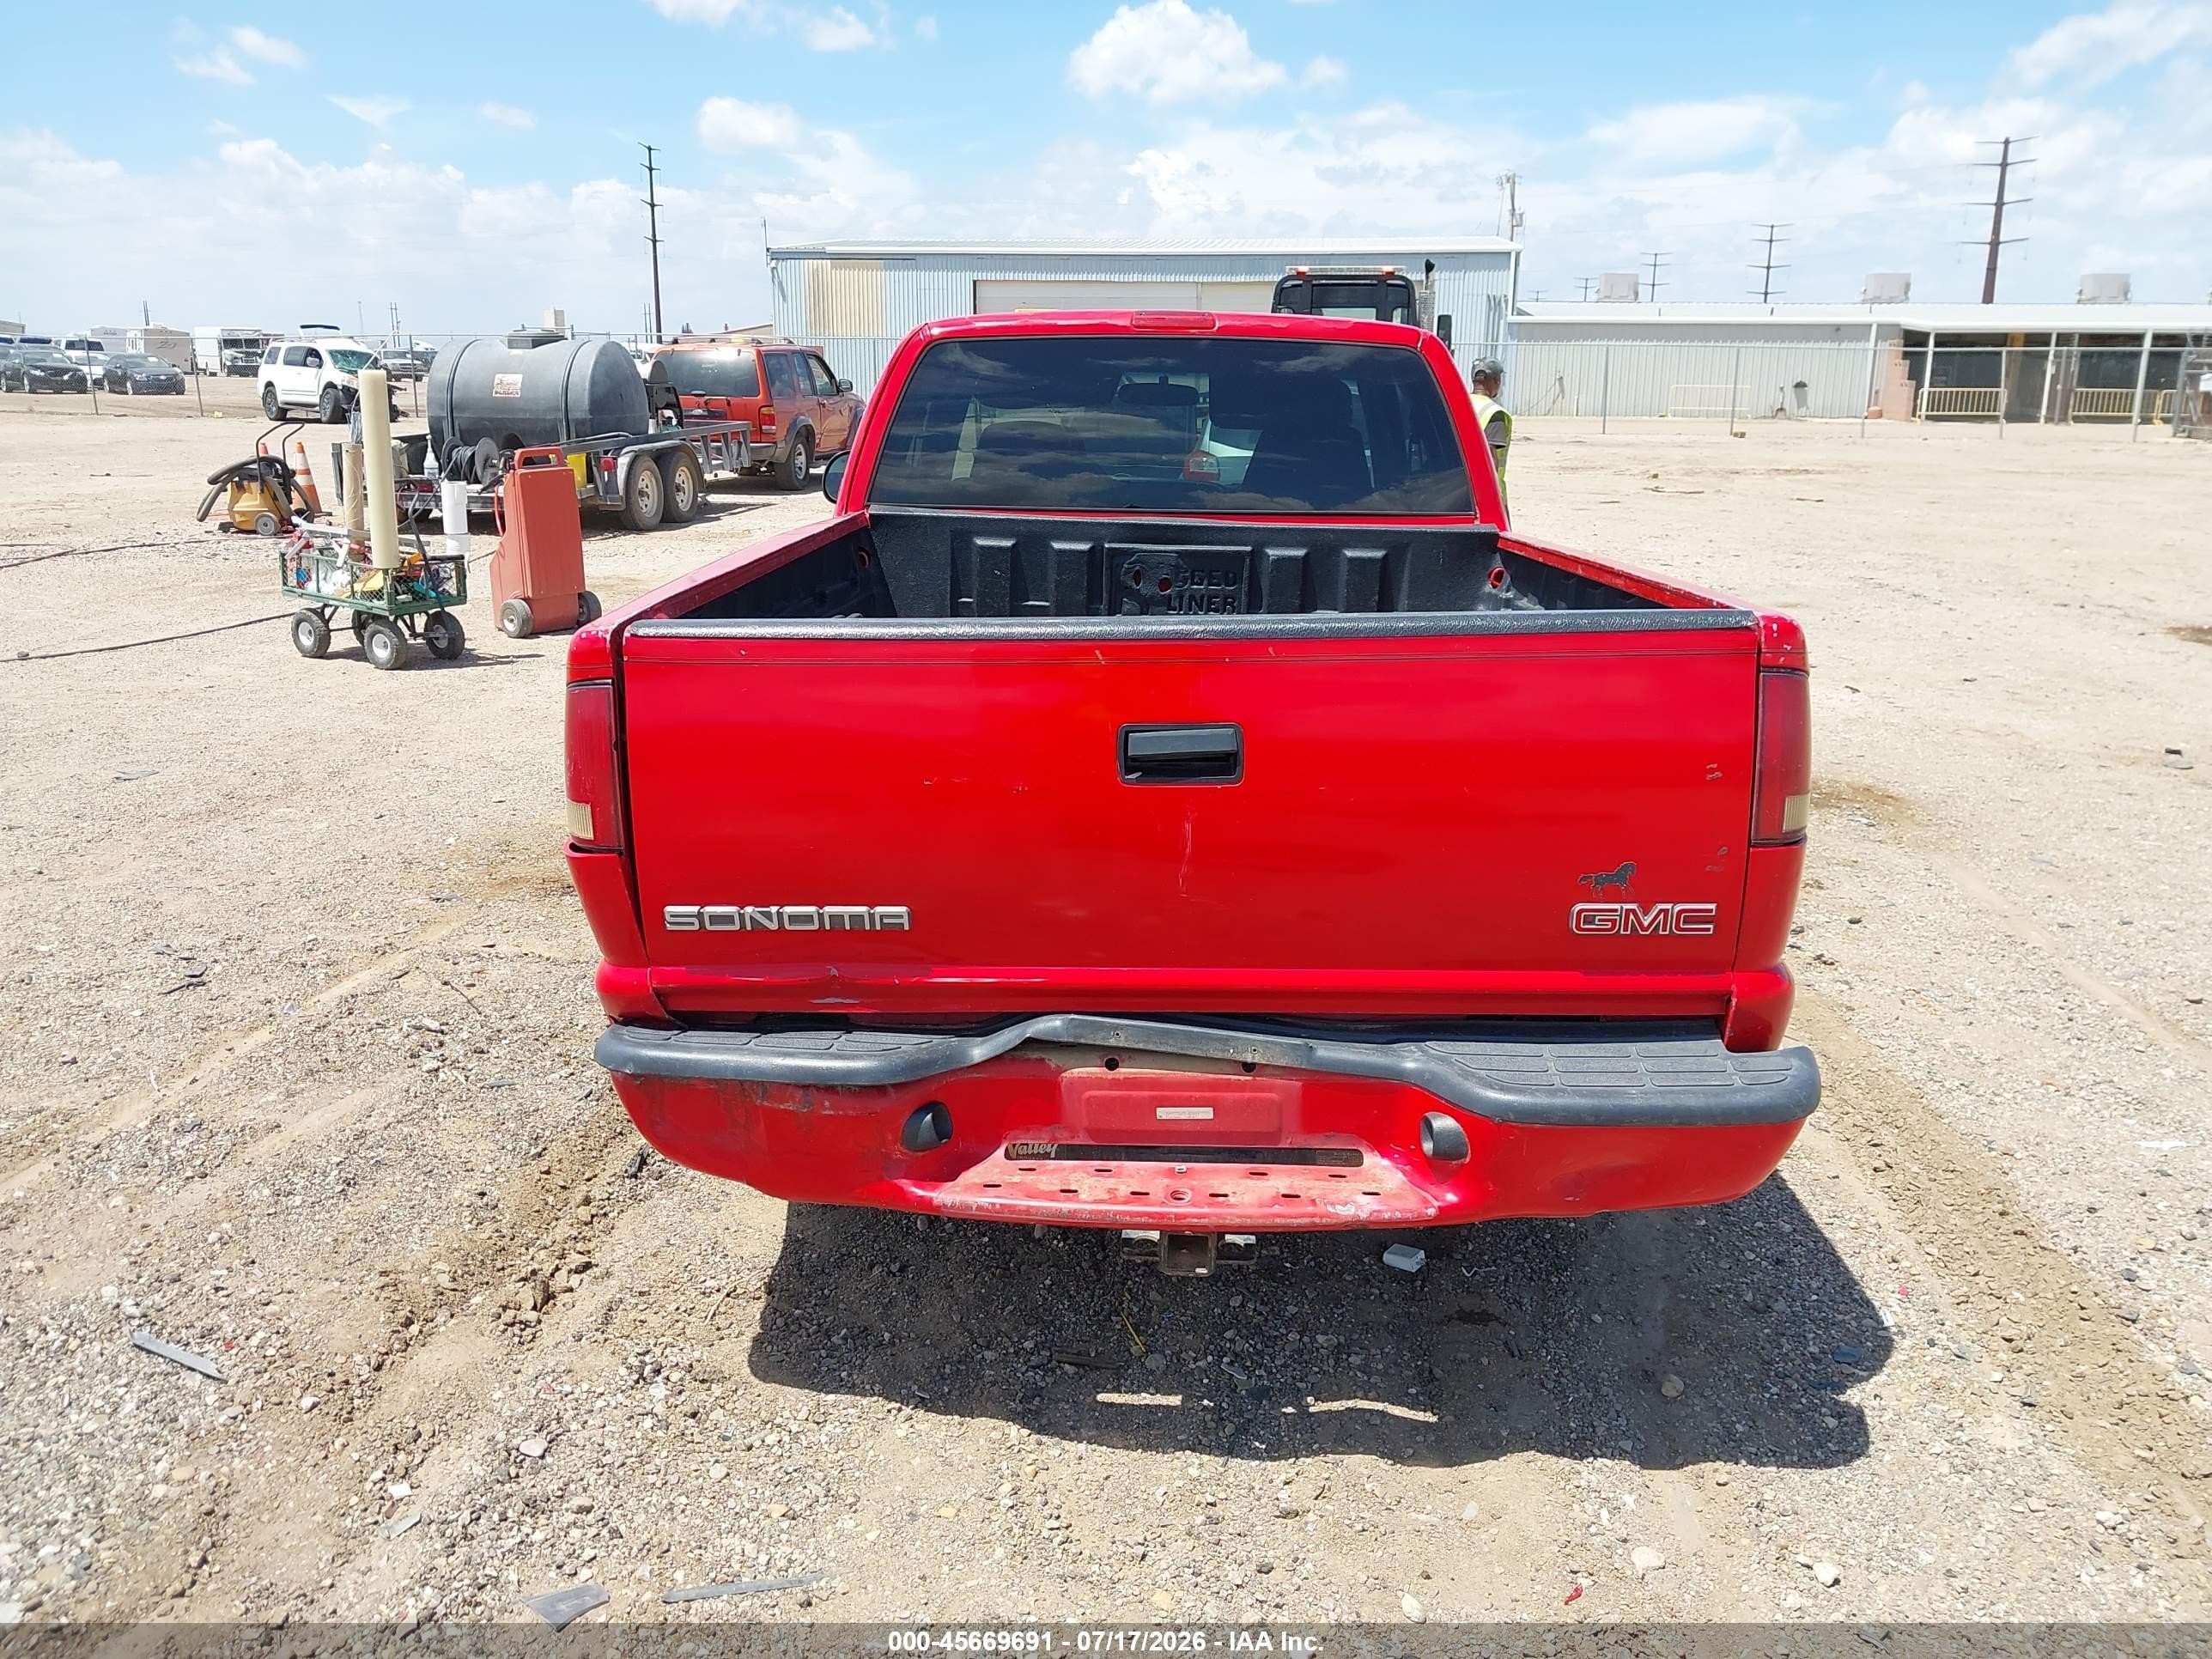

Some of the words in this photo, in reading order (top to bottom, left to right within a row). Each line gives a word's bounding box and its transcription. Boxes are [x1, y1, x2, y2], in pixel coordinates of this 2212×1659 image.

[1166, 593, 1237, 615] LINER
[663, 904, 912, 932] SONOMA
[1570, 902, 1718, 935] GMC
[1006, 1142, 1059, 1159] Valley
